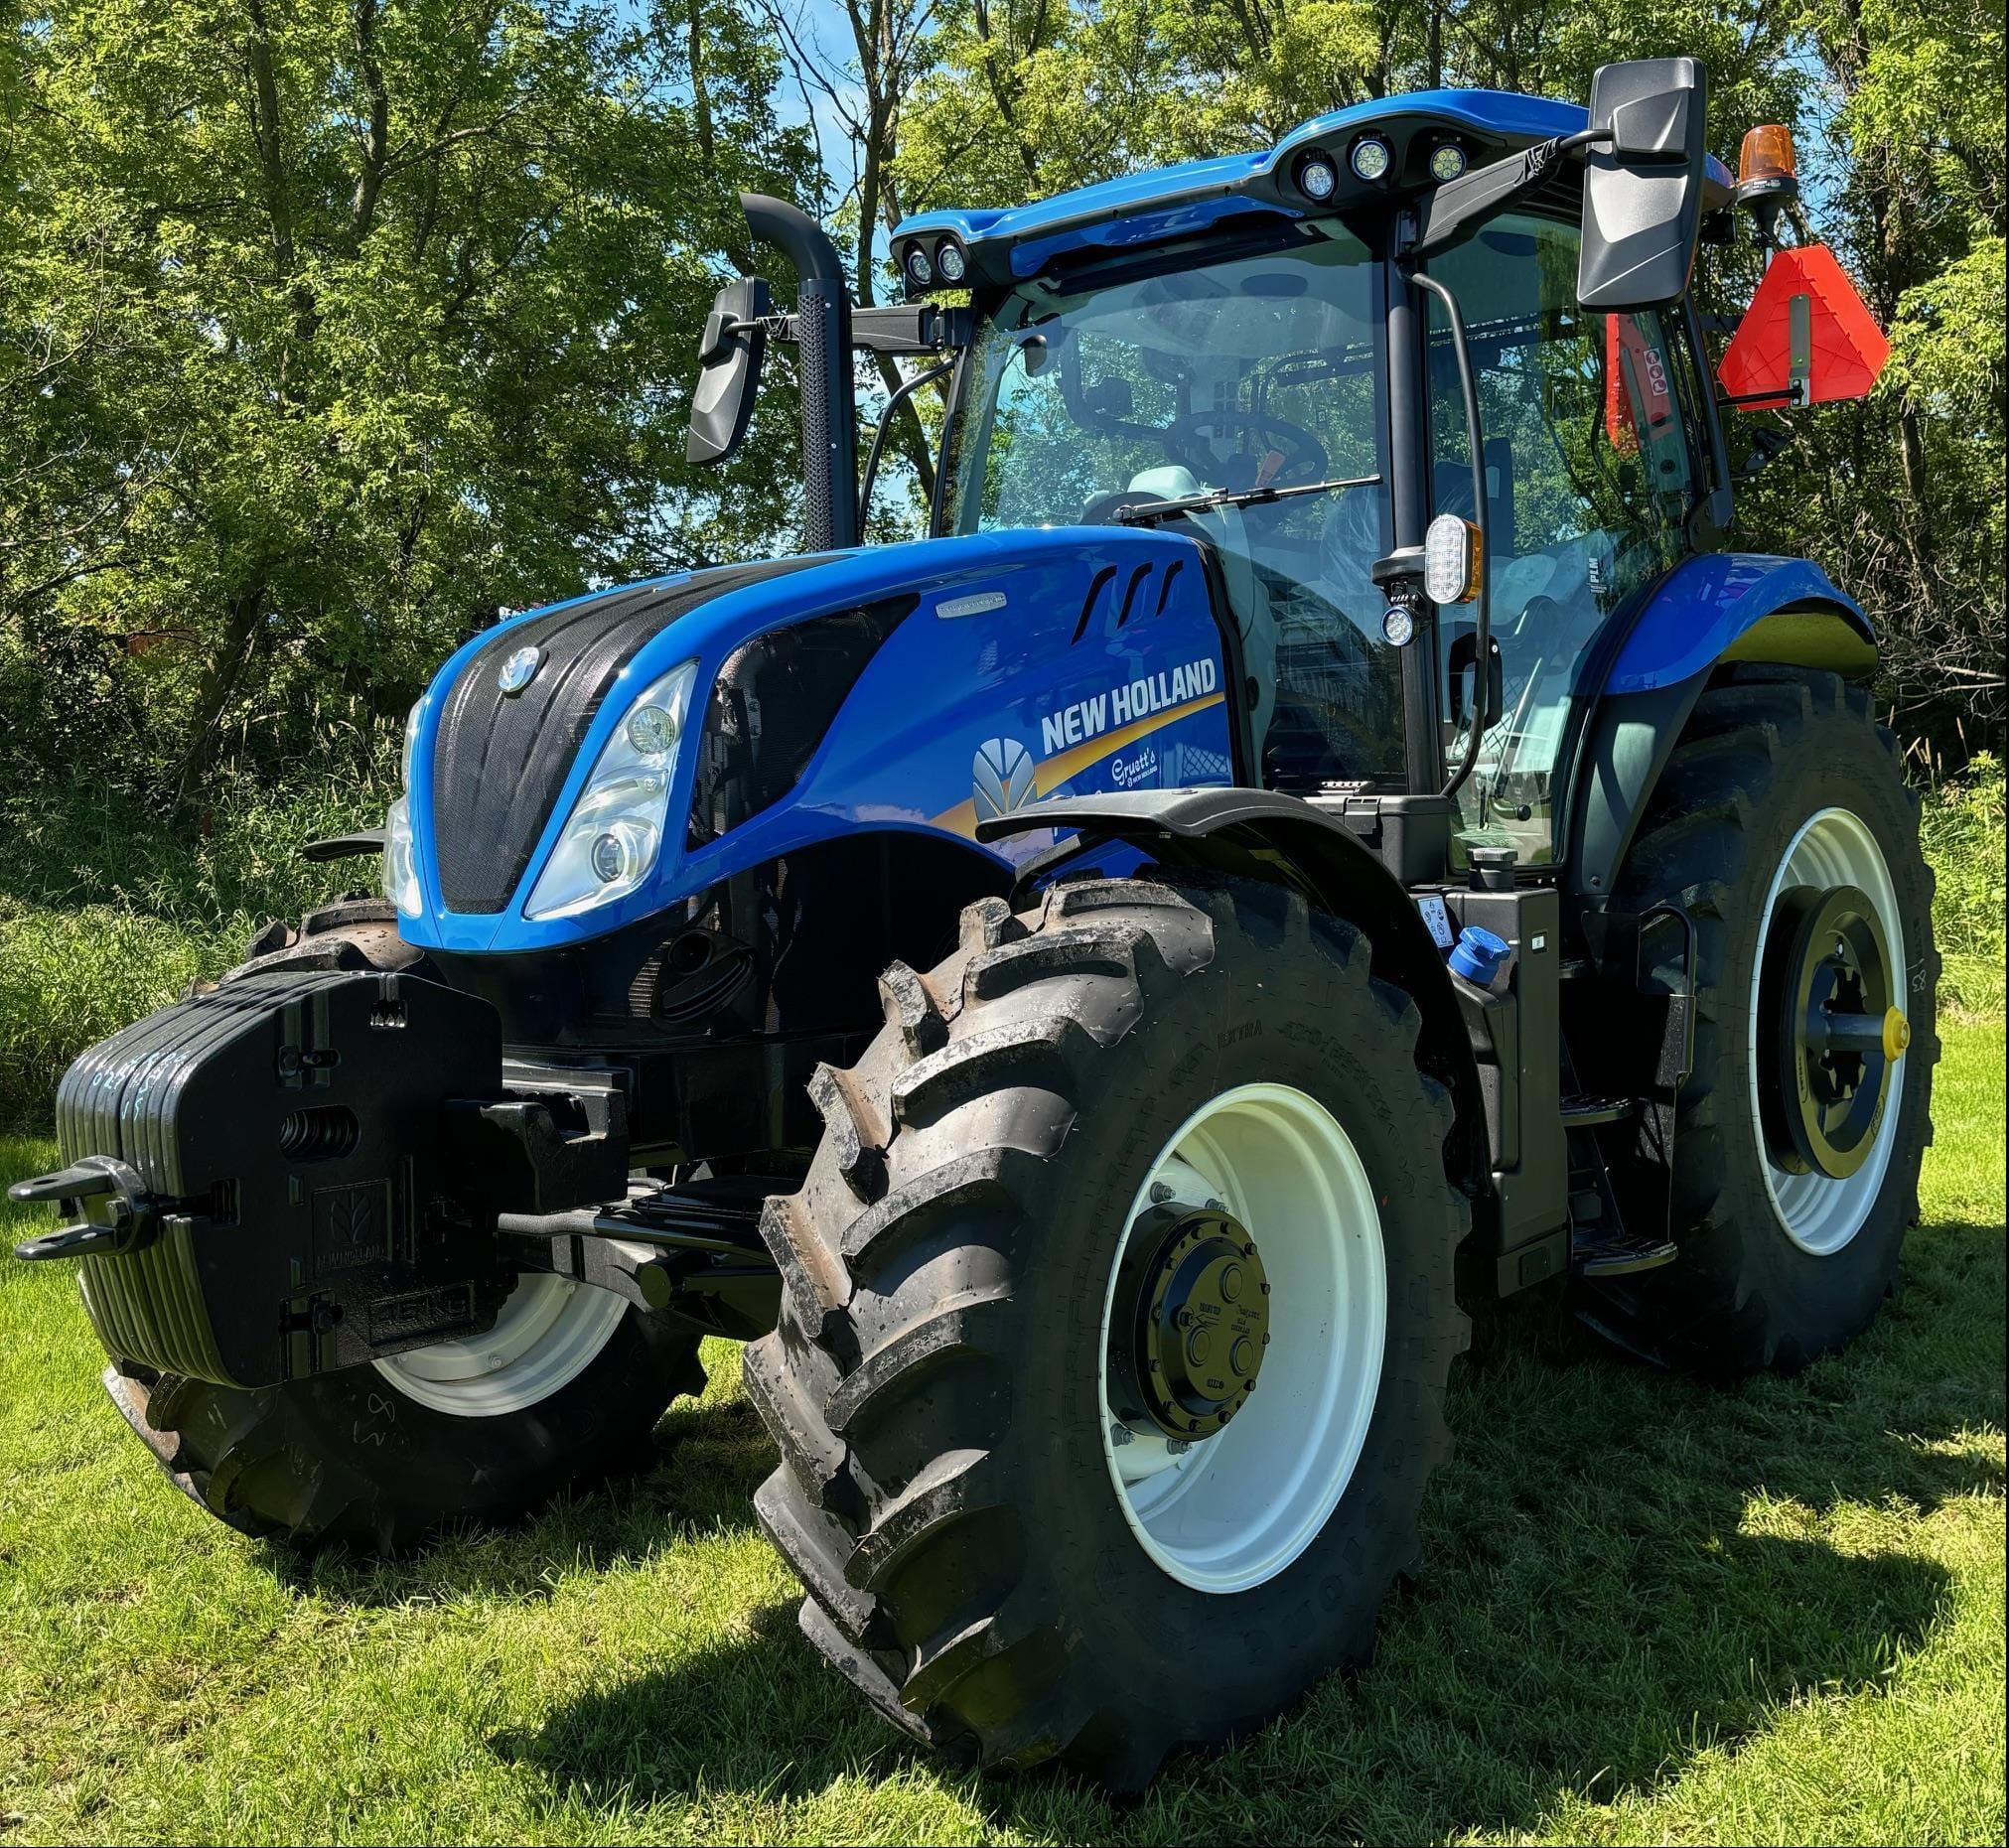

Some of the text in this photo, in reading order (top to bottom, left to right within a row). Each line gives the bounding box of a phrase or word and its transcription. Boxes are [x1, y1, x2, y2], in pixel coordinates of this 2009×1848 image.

[1588, 557, 1600, 583] PLM
[1042, 657, 1217, 755] NEW HOLLAND
[1111, 747, 1156, 786] Gruett's
[1217, 1018, 1263, 1050] EXTRA
